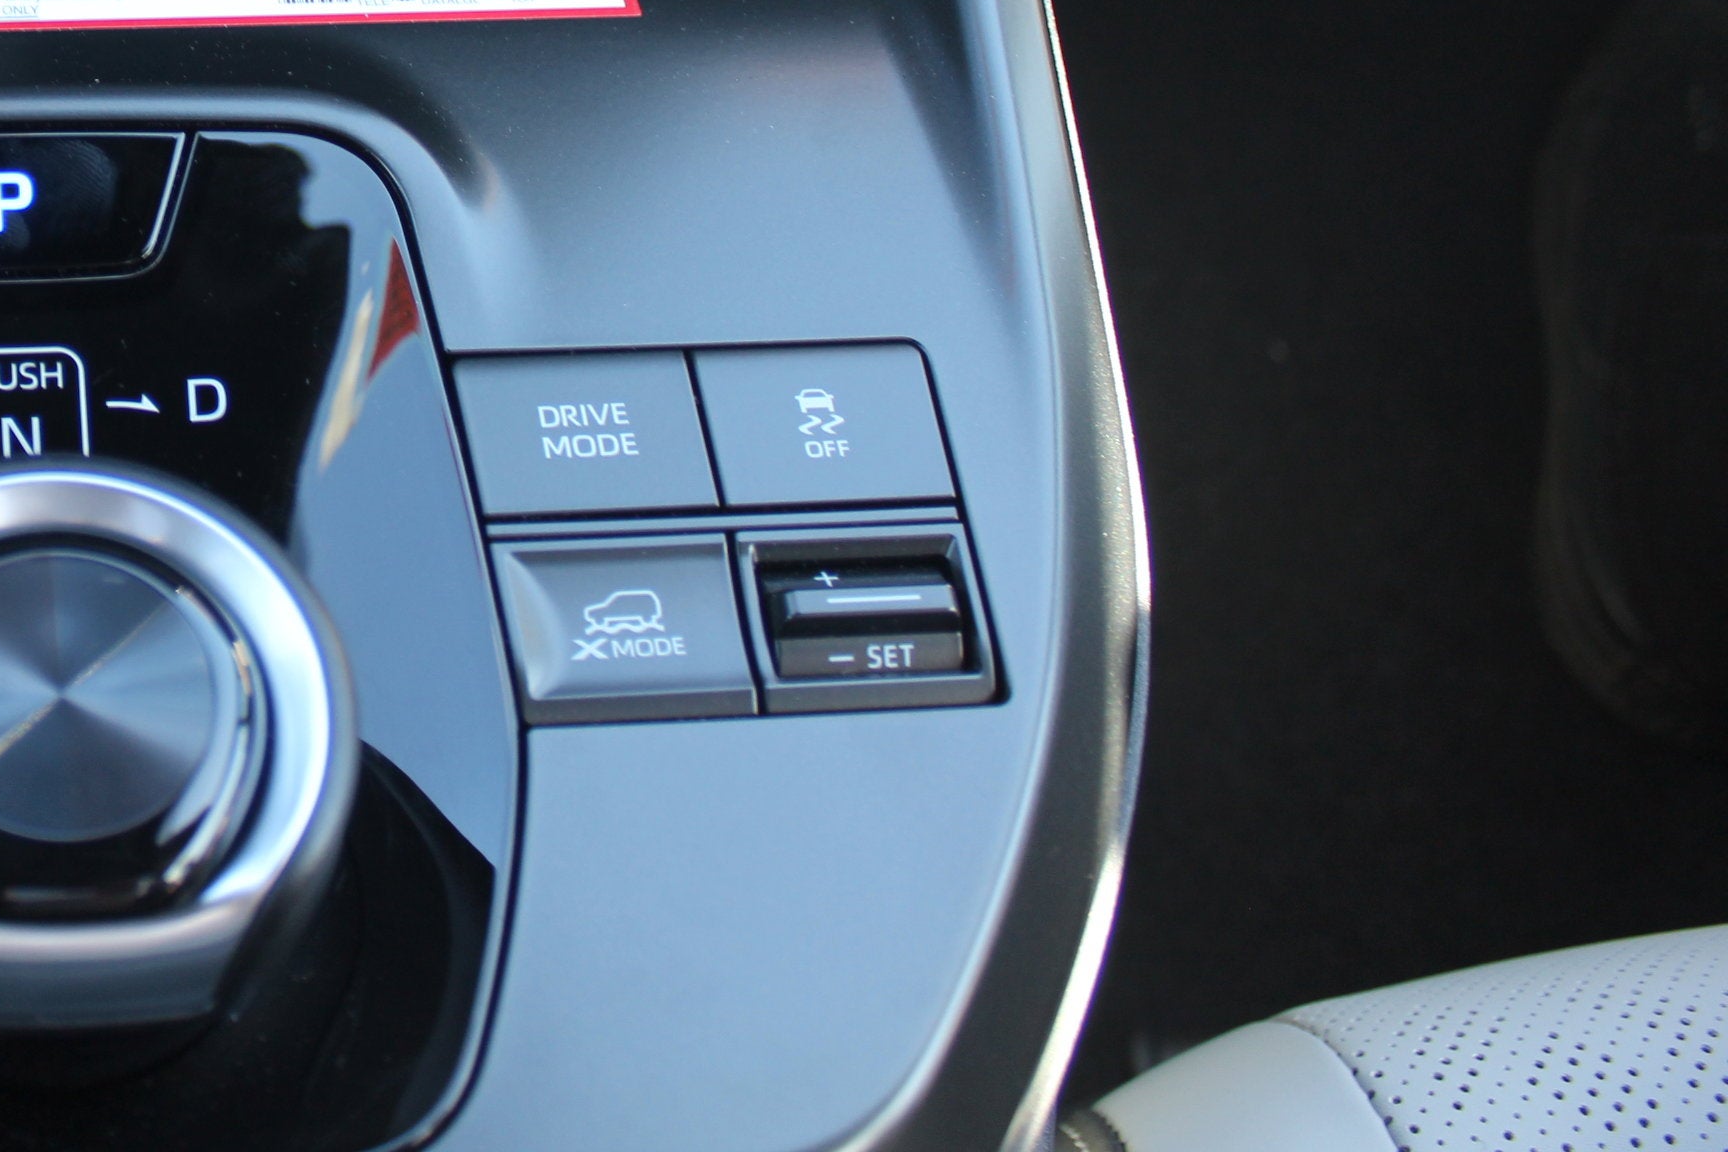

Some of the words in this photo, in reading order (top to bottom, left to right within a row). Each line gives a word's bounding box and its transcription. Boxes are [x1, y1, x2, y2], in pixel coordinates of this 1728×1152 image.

[2, 4, 40, 16] ONLY
[186, 378, 228, 424] D
[537, 402, 629, 429] DRIVE
[0, 416, 42, 459] N
[541, 433, 639, 459] MODE
[804, 440, 850, 459] OFF
[866, 645, 915, 670] SET
